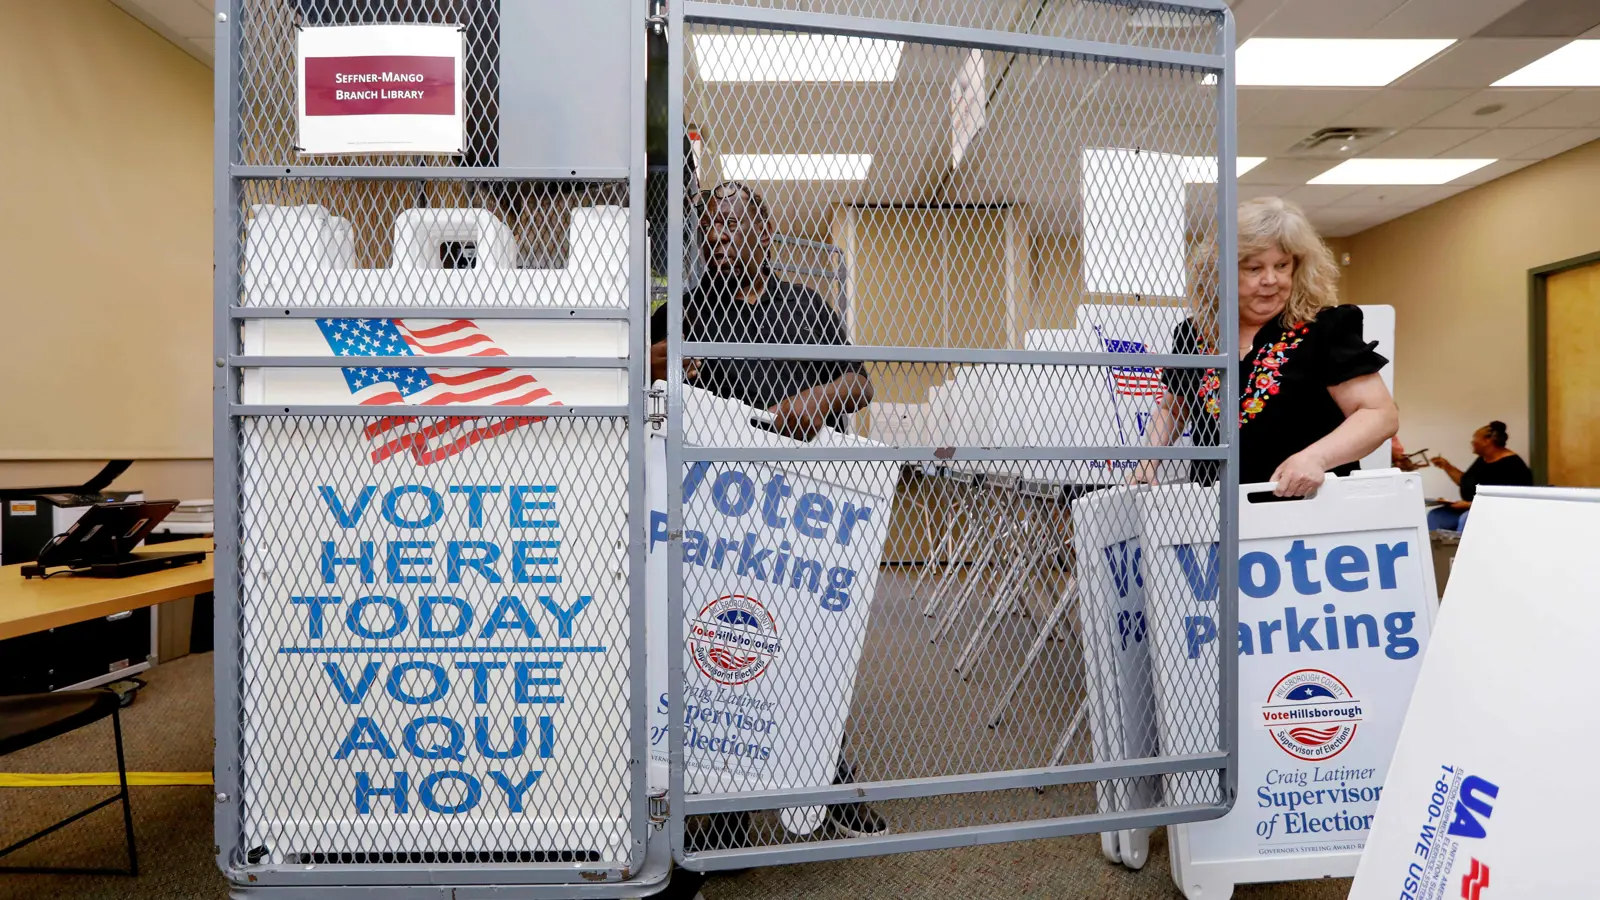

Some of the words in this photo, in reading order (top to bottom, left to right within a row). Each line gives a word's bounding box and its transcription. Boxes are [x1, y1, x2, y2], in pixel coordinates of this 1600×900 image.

[335, 72, 424, 84] SEFFNER-MANGO
[336, 89, 378, 100] BRANCH
[381, 88, 424, 99] LIBRARY
[317, 484, 560, 529] VOTE
[320, 540, 563, 584] HERE
[289, 595, 594, 640] TODAY
[321, 660, 565, 705] VOTE
[734, 660, 765, 680] Eectons
[1275, 673, 1321, 698] HILLSBOROUGH
[1320, 676, 1345, 696] COUNTY
[683, 679, 713, 704] raig
[656, 692, 776, 735] Spervisor
[1262, 705, 1363, 721] VoteHillsborough
[333, 715, 554, 763] AQUI
[683, 725, 772, 761] lections
[1277, 730, 1314, 756] Supervisor
[1315, 746, 1324, 756] of
[1323, 726, 1351, 754] Elections
[355, 770, 545, 815] HOY
[1265, 768, 1308, 787] Craig
[1313, 766, 1376, 783] Latimer
[1449, 768, 1464, 802] ELECTION
[1256, 781, 1384, 812] Supervisor
[1446, 774, 1500, 839] UA
[1256, 813, 1280, 840] of
[1284, 809, 1375, 835] Election
[1438, 800, 1454, 839] EQUIPMENT
[1428, 842, 1441, 872] SERVICE
[1432, 836, 1451, 881] ELECTION
[1444, 841, 1459, 875] UNITED
